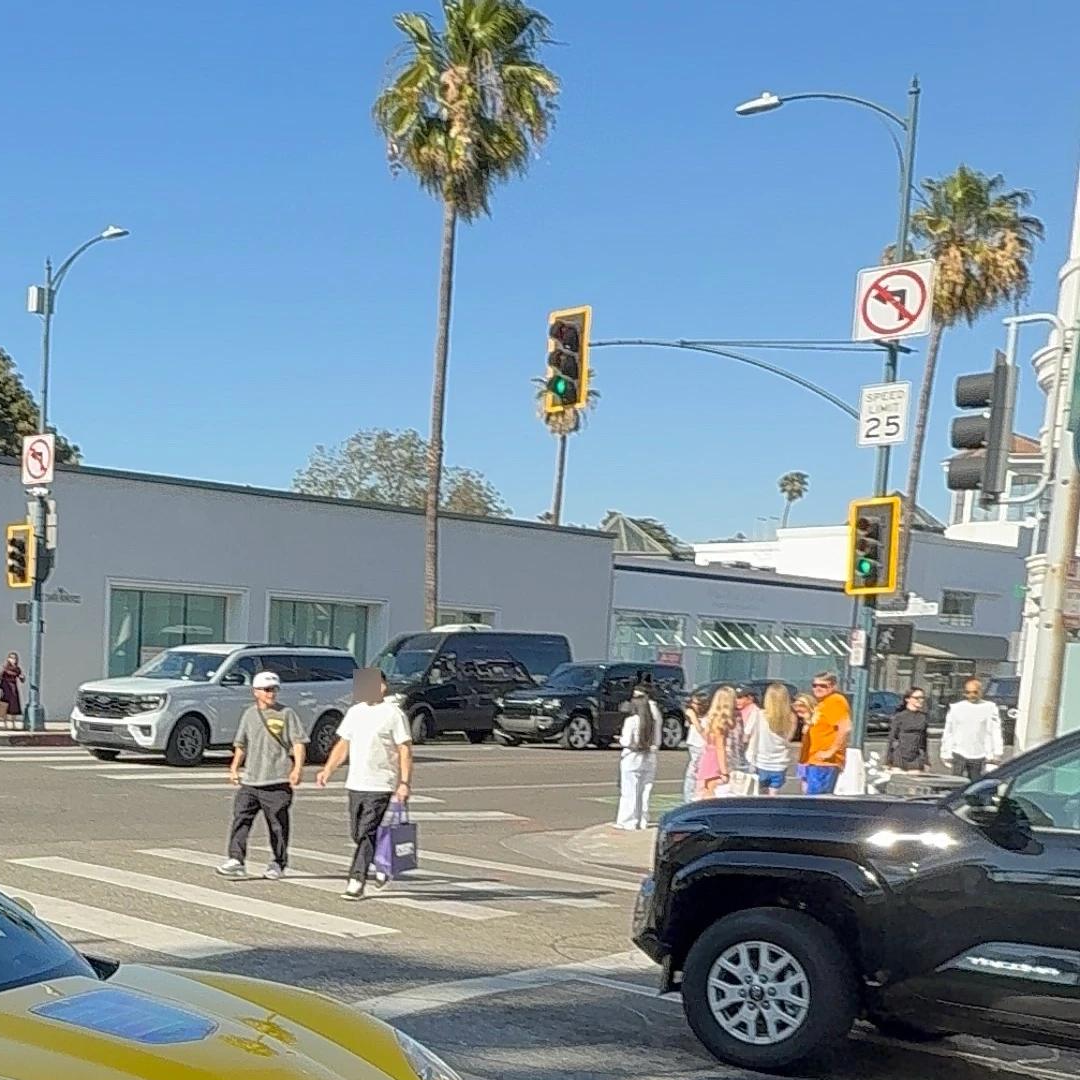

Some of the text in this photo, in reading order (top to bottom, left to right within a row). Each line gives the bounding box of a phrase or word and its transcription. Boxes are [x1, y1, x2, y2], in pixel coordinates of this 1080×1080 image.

[865, 389, 904, 403] SPEED
[868, 402, 899, 415] LIMIT
[864, 415, 901, 438] 25
